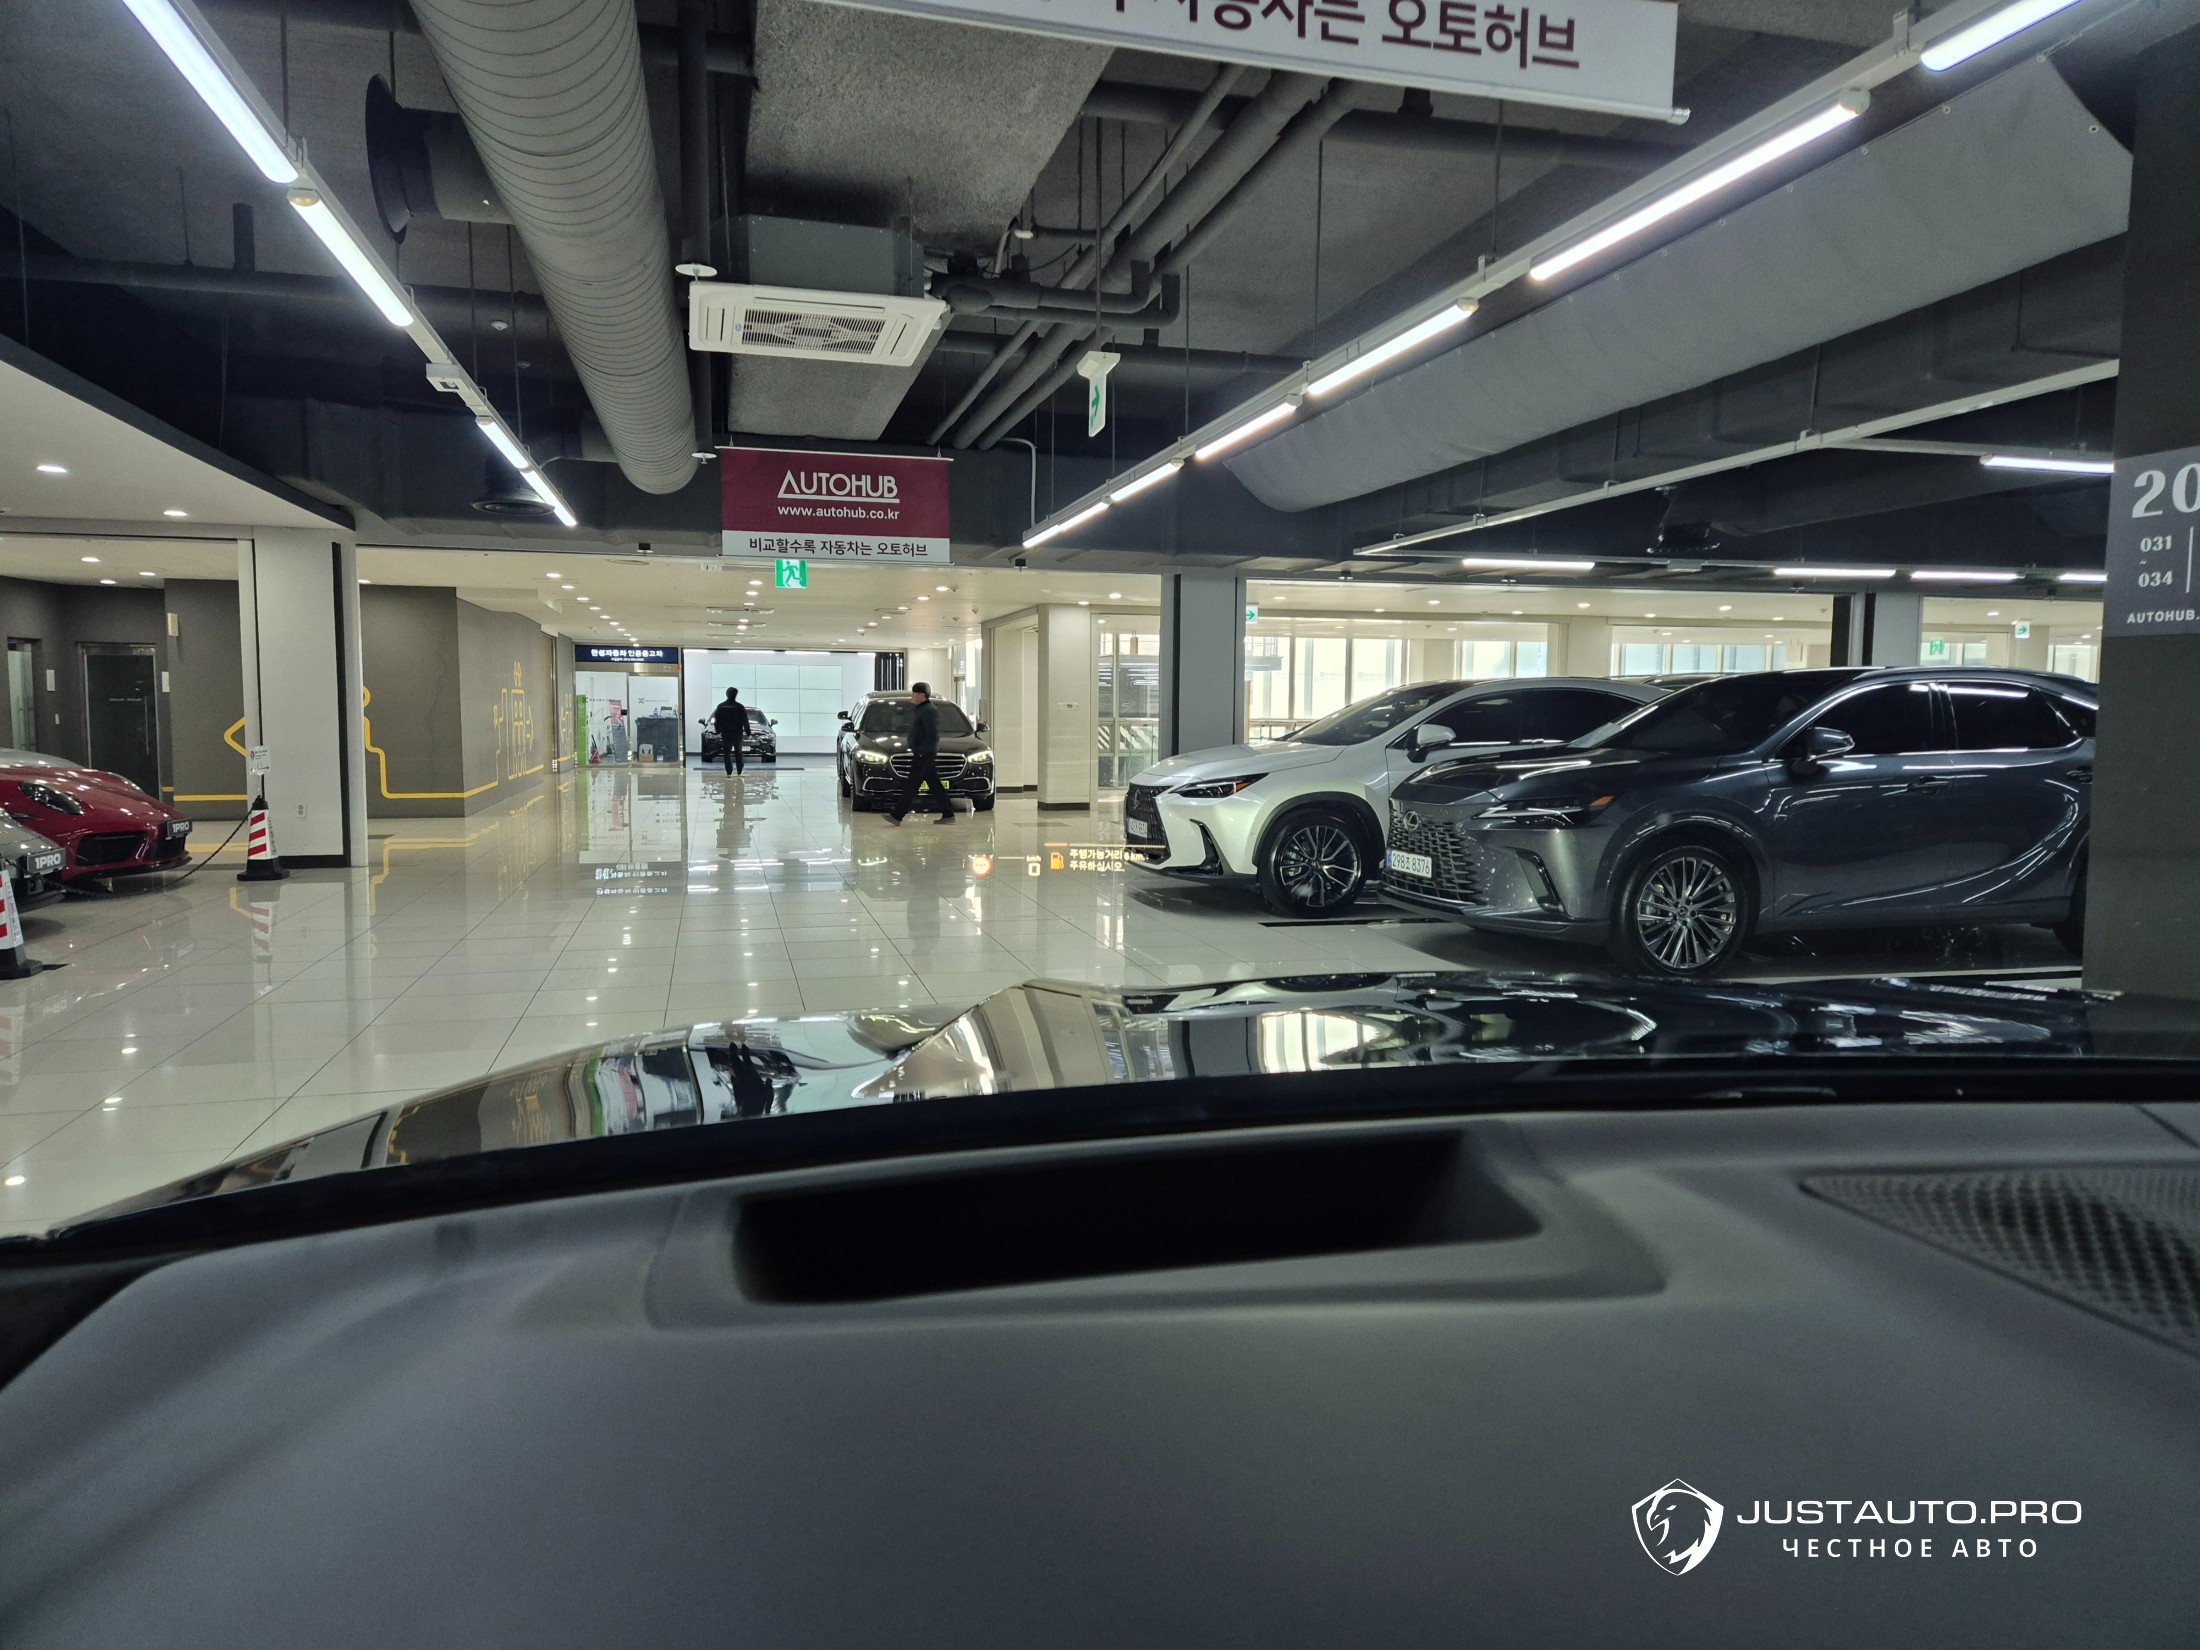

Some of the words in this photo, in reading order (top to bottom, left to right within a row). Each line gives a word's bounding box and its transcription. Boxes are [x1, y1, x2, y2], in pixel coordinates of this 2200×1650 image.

[1382, 0, 1579, 70] 오토허브
[777, 469, 900, 503] AUTOHUB
[2131, 463, 2200, 519] 20
[777, 505, 900, 520] www.autohub.co.kr
[749, 537, 816, 555] 비교할수록
[820, 539, 873, 556] 자동차는
[876, 541, 928, 557] 오토허브
[2140, 535, 2173, 553] 031
[2138, 570, 2173, 588] 034
[172, 821, 190, 832] 1PRO
[35, 853, 61, 869] 1PRO
[1412, 857, 1431, 875] 8376
